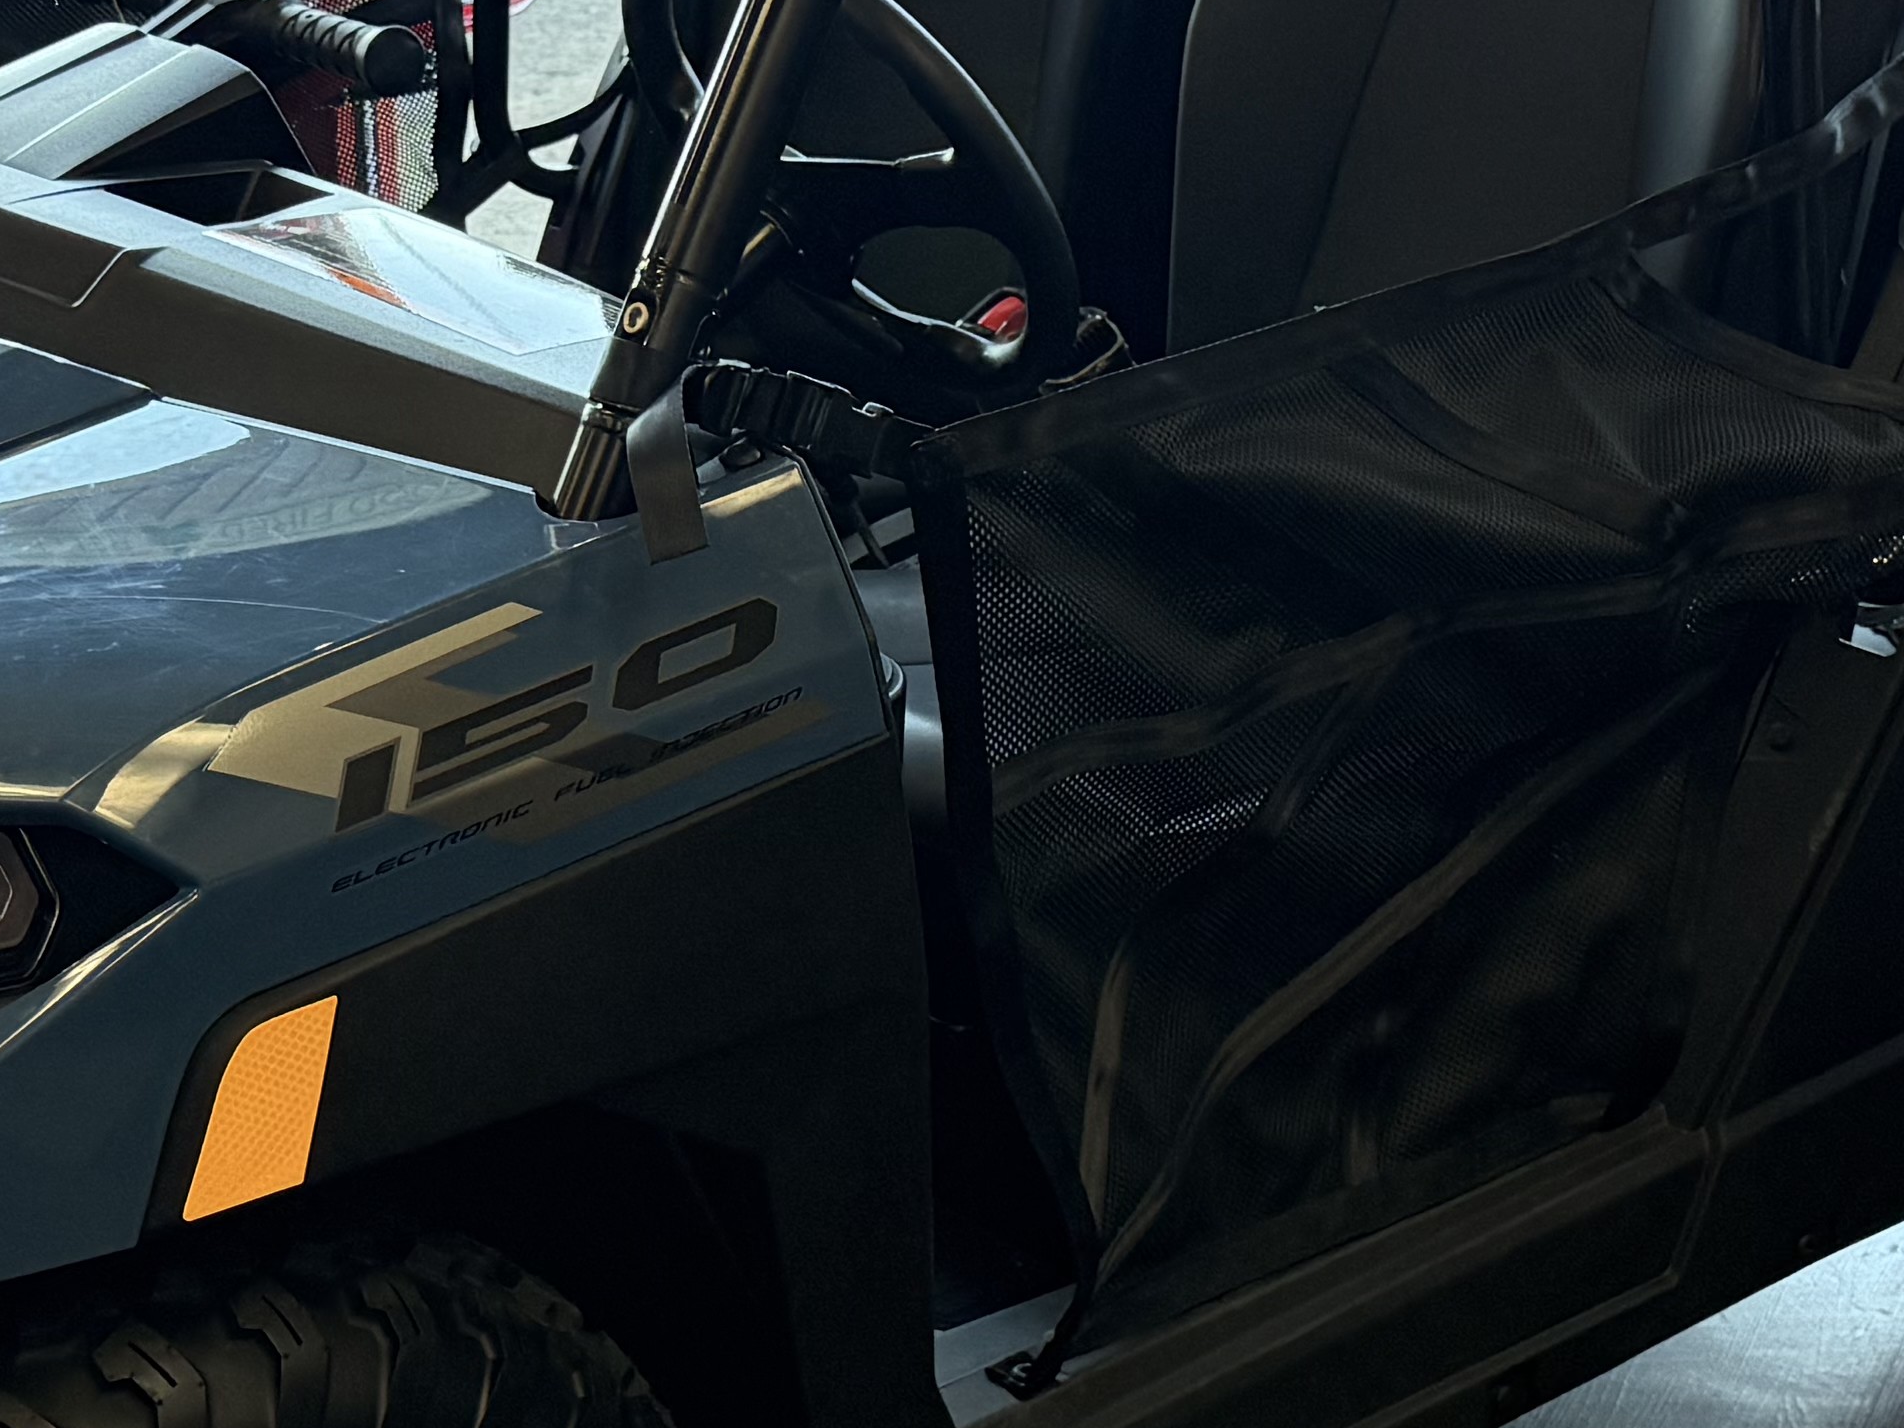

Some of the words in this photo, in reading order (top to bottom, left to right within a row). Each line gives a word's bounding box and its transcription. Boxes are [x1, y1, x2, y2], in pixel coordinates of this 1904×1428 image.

[331, 799, 534, 893] ELECTRONIC
[554, 764, 632, 802] FUEL
[649, 686, 804, 763] INJECTION
[335, 597, 778, 832] 150
